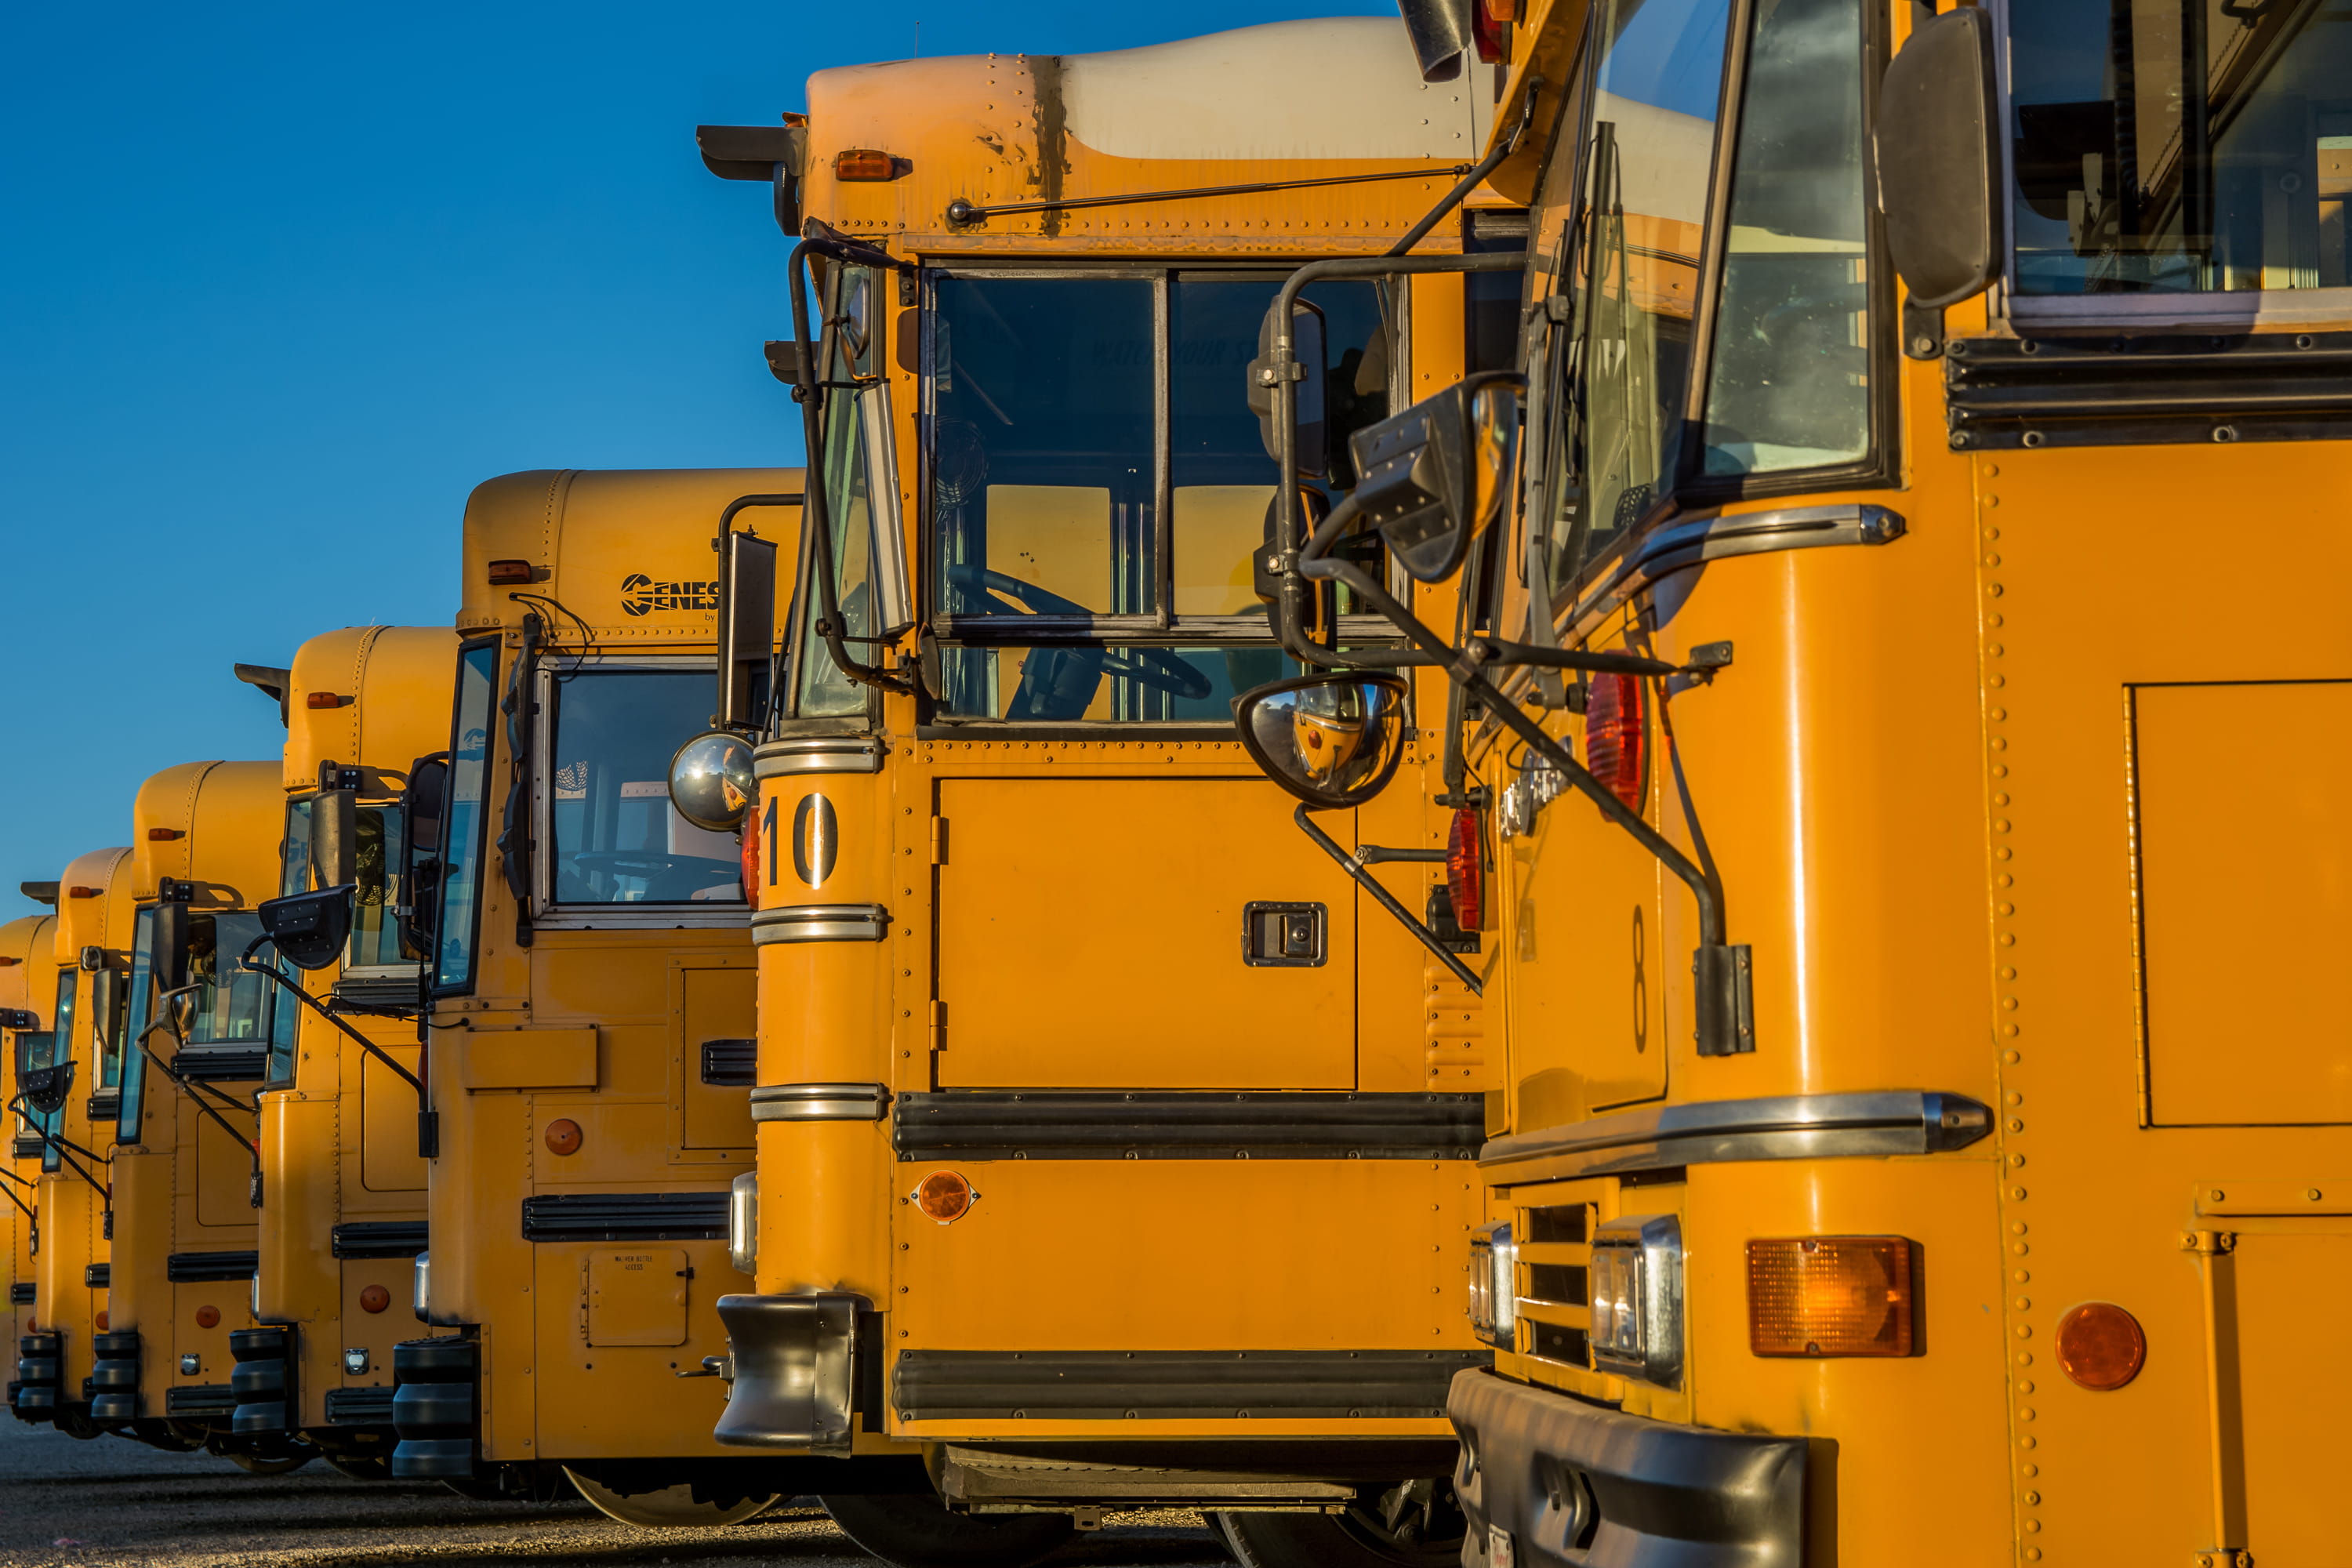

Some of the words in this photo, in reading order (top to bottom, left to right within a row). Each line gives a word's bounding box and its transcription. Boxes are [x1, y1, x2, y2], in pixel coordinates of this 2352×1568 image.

[705, 612, 715, 622] by
[763, 792, 838, 889] 10
[1633, 904, 1646, 1054] 8
